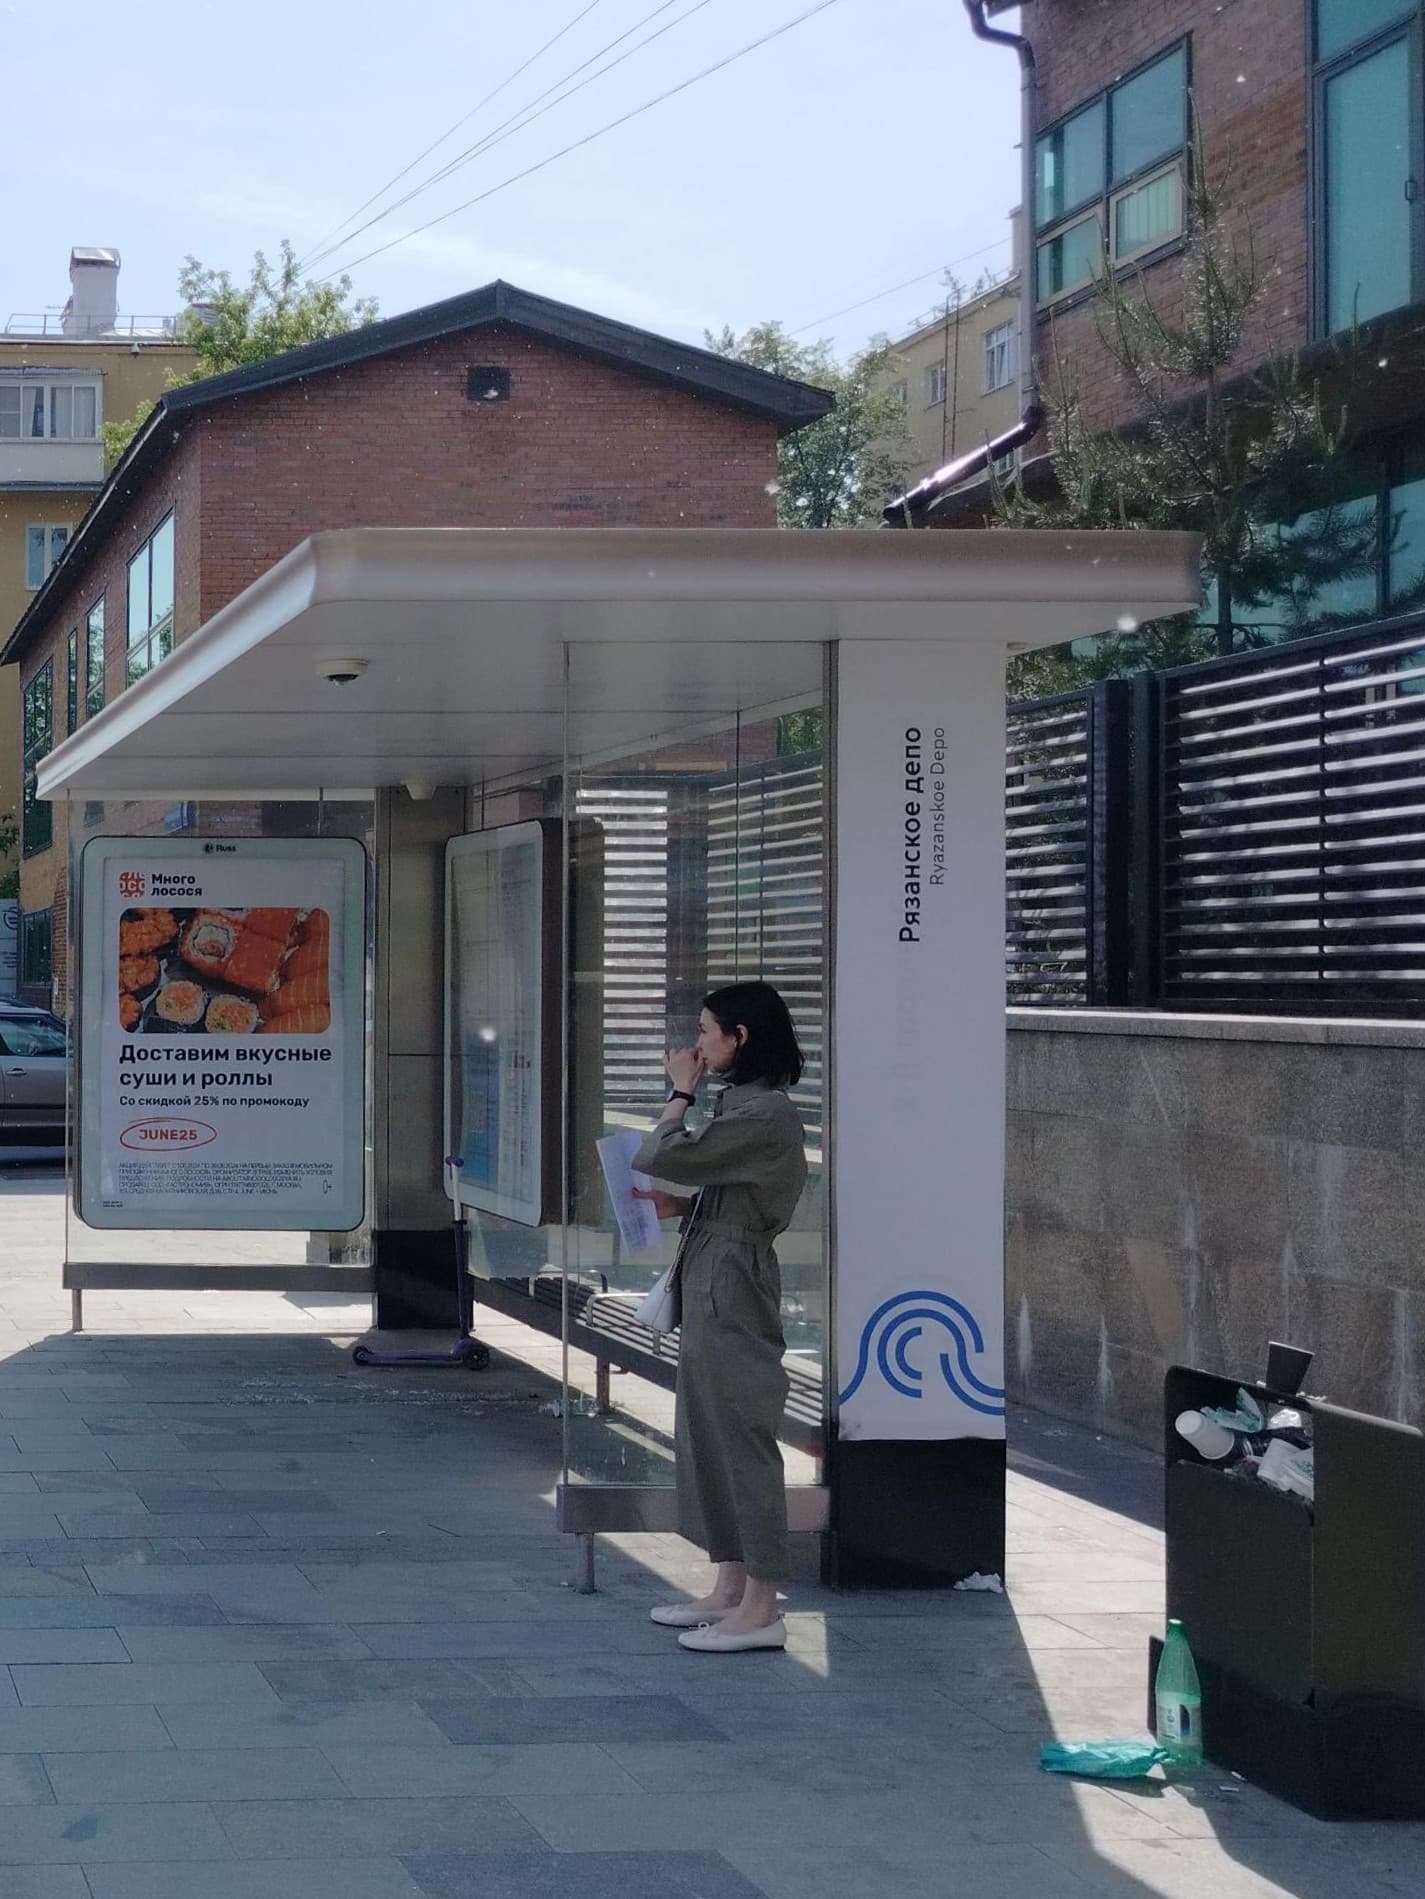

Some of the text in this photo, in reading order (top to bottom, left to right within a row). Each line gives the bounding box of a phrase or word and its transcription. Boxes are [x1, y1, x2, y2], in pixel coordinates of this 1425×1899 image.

[929, 727, 948, 885] Ryazanskoe Depo
[899, 727, 924, 942] Рязанское депо
[151, 873, 196, 884] Много
[151, 887, 202, 896] лосося
[119, 1045, 332, 1064] Доставим вкусные
[119, 1072, 273, 1089] суши и роллы
[119, 1095, 309, 1108] Со скидкой 25% по промокоду
[138, 1129, 198, 1140] JUNE25
